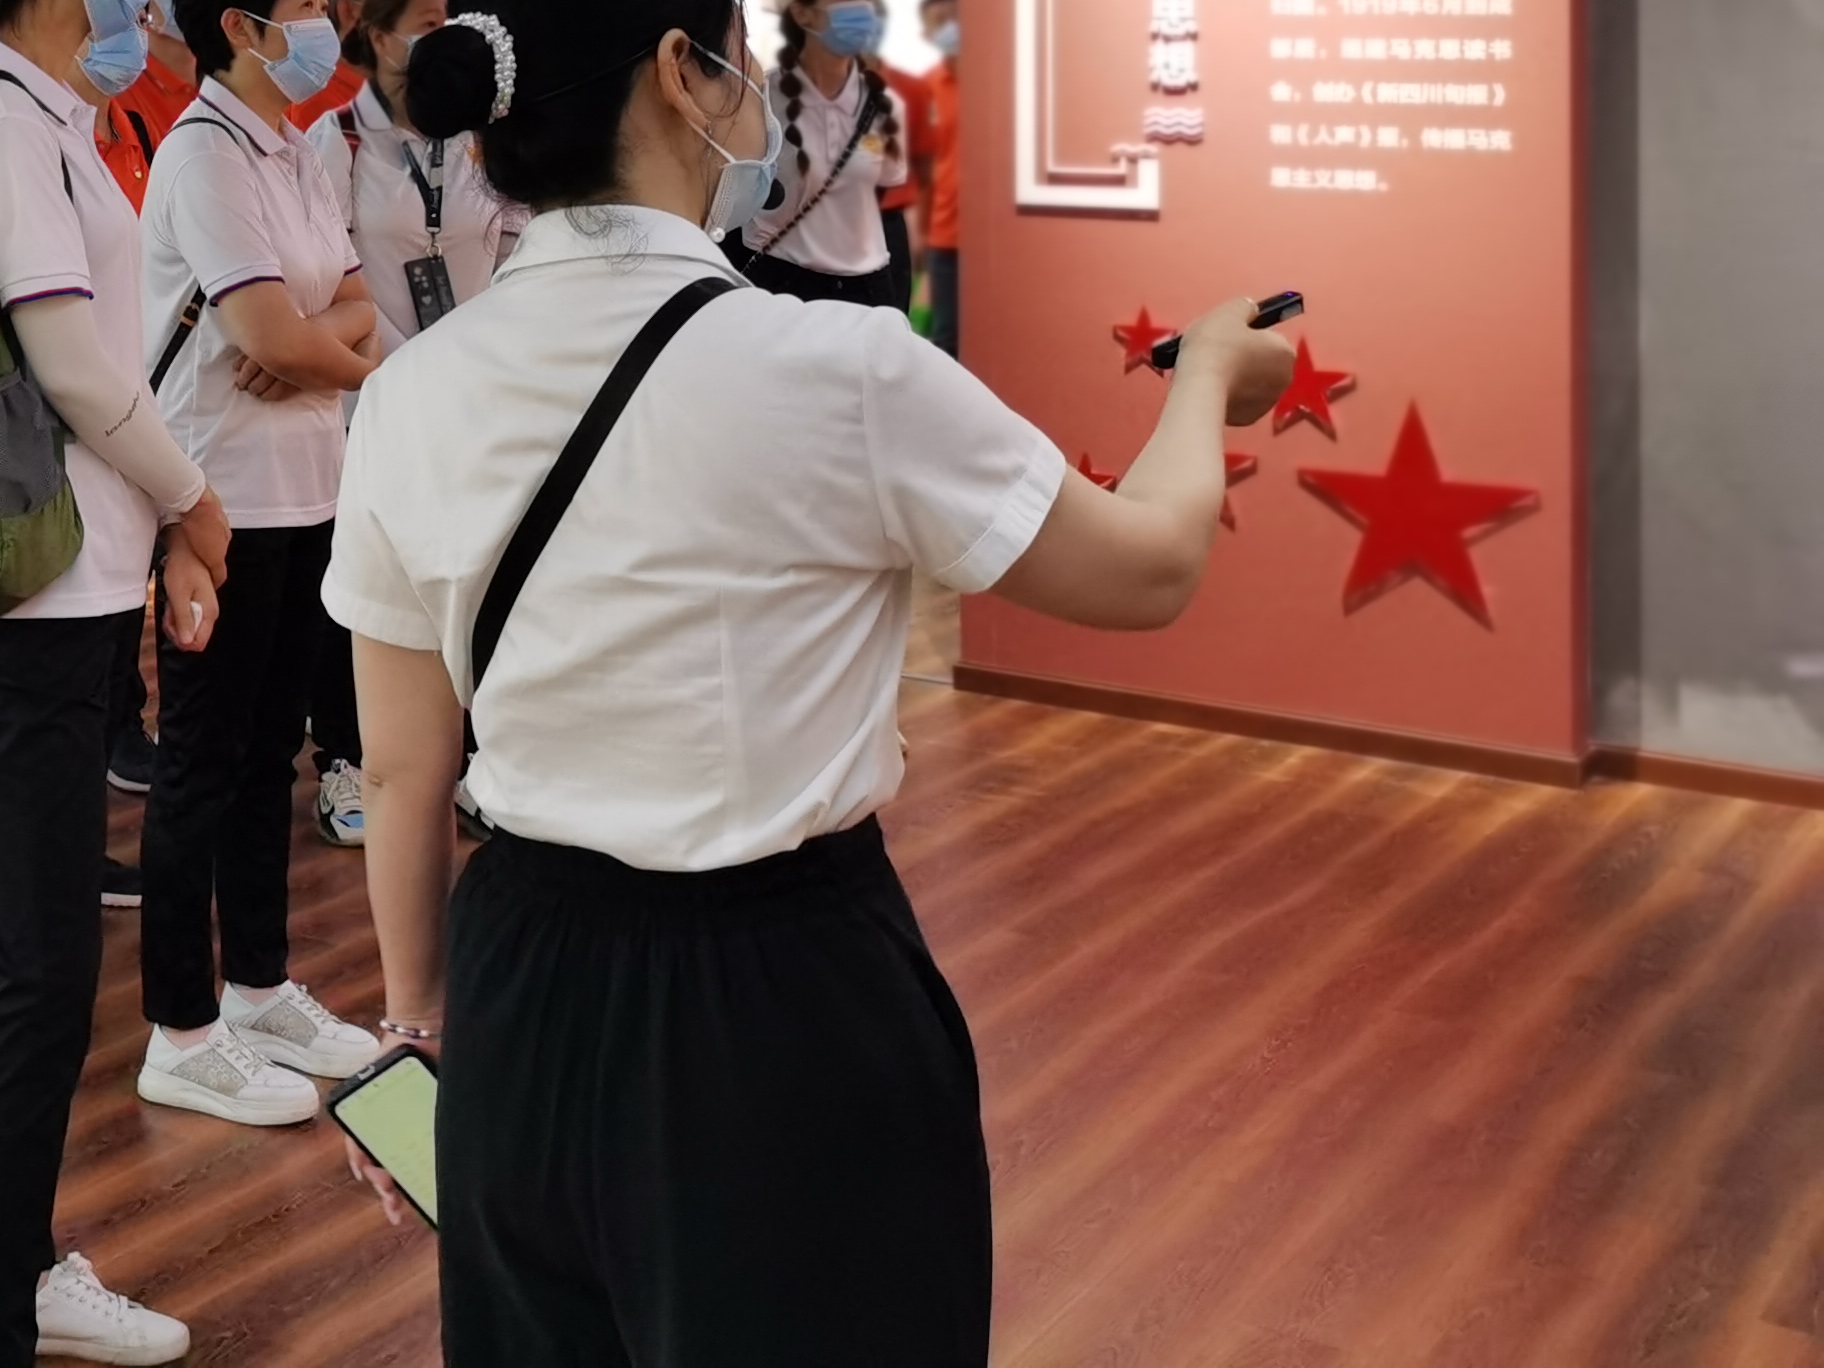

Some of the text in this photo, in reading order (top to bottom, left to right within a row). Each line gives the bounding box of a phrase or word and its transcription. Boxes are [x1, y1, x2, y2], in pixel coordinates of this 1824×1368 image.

[1270, 166, 1389, 192] 思主义思想。
